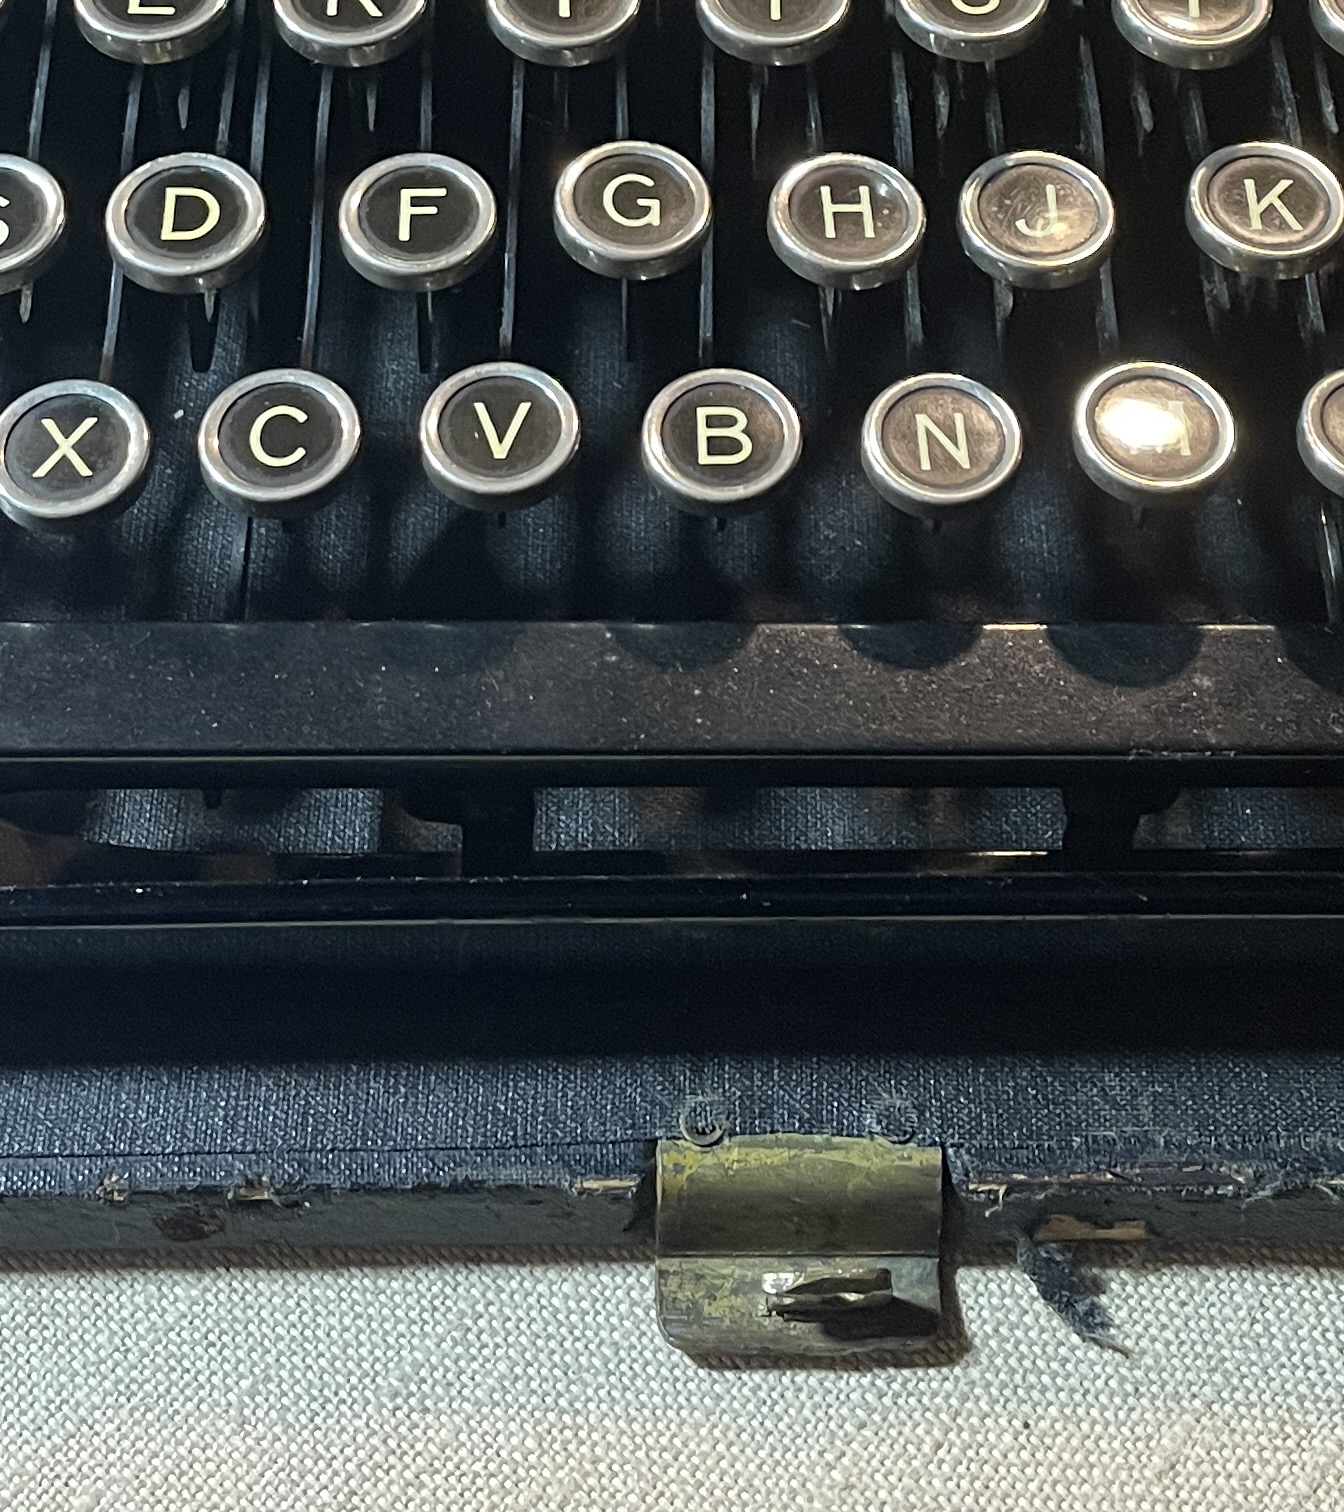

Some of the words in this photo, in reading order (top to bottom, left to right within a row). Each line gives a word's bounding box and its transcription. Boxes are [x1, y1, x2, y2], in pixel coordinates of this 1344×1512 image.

[161, 188, 220, 240] D
[399, 188, 446, 241] F
[603, 174, 660, 226] G
[818, 184, 875, 239] H
[1014, 185, 1060, 240] J
[1243, 179, 1303, 231] K
[32, 418, 97, 477] X
[249, 406, 307, 466] C
[474, 402, 531, 459] V
[697, 407, 752, 464] B
[915, 413, 970, 471] N
